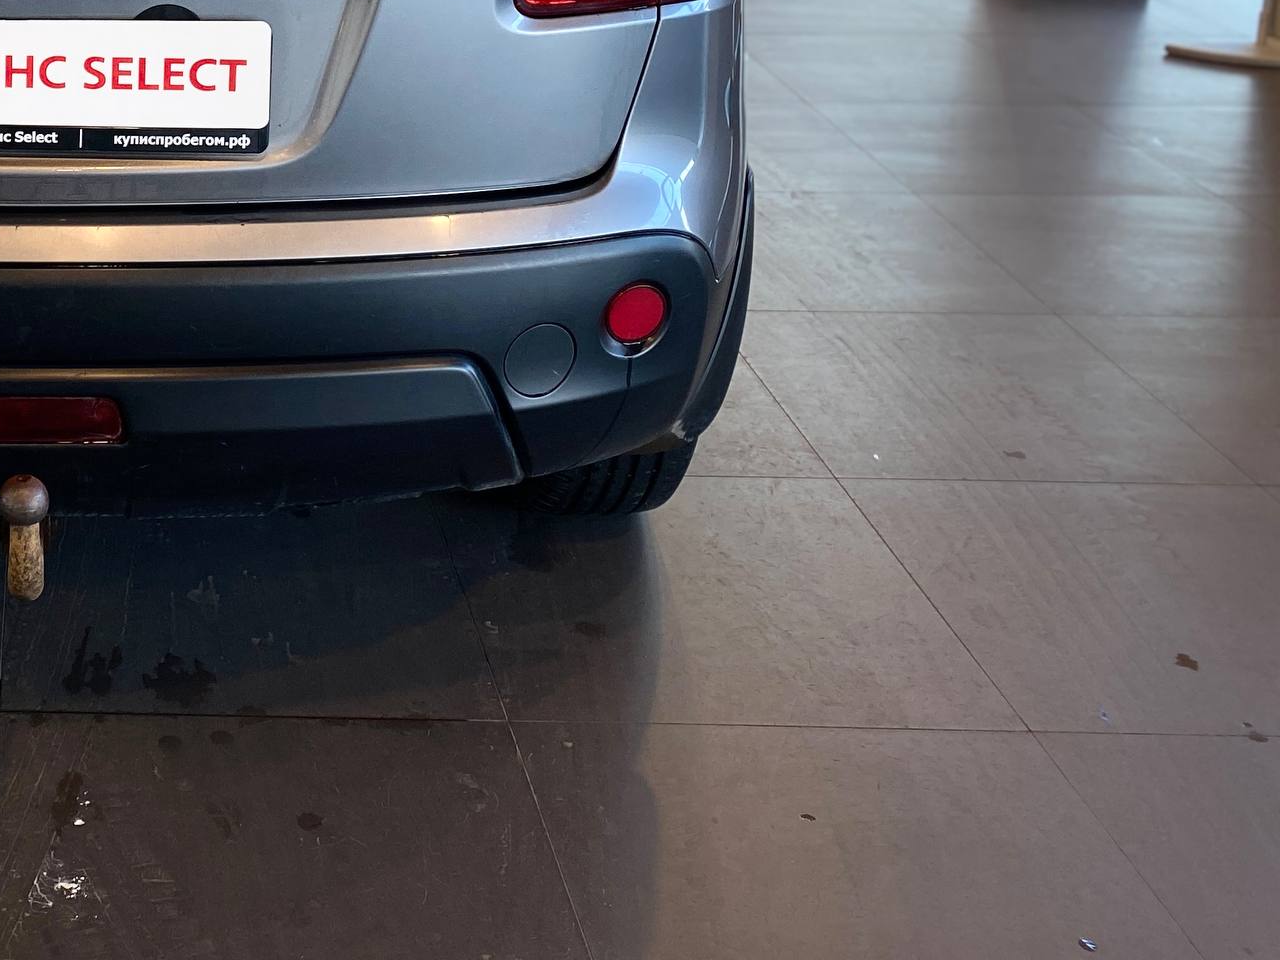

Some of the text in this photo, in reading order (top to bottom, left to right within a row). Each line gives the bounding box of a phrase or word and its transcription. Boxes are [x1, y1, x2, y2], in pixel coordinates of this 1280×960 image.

[83, 55, 247, 93] SELECT
[14, 130, 59, 145] Select
[113, 133, 252, 150] куписпробегом.рф
